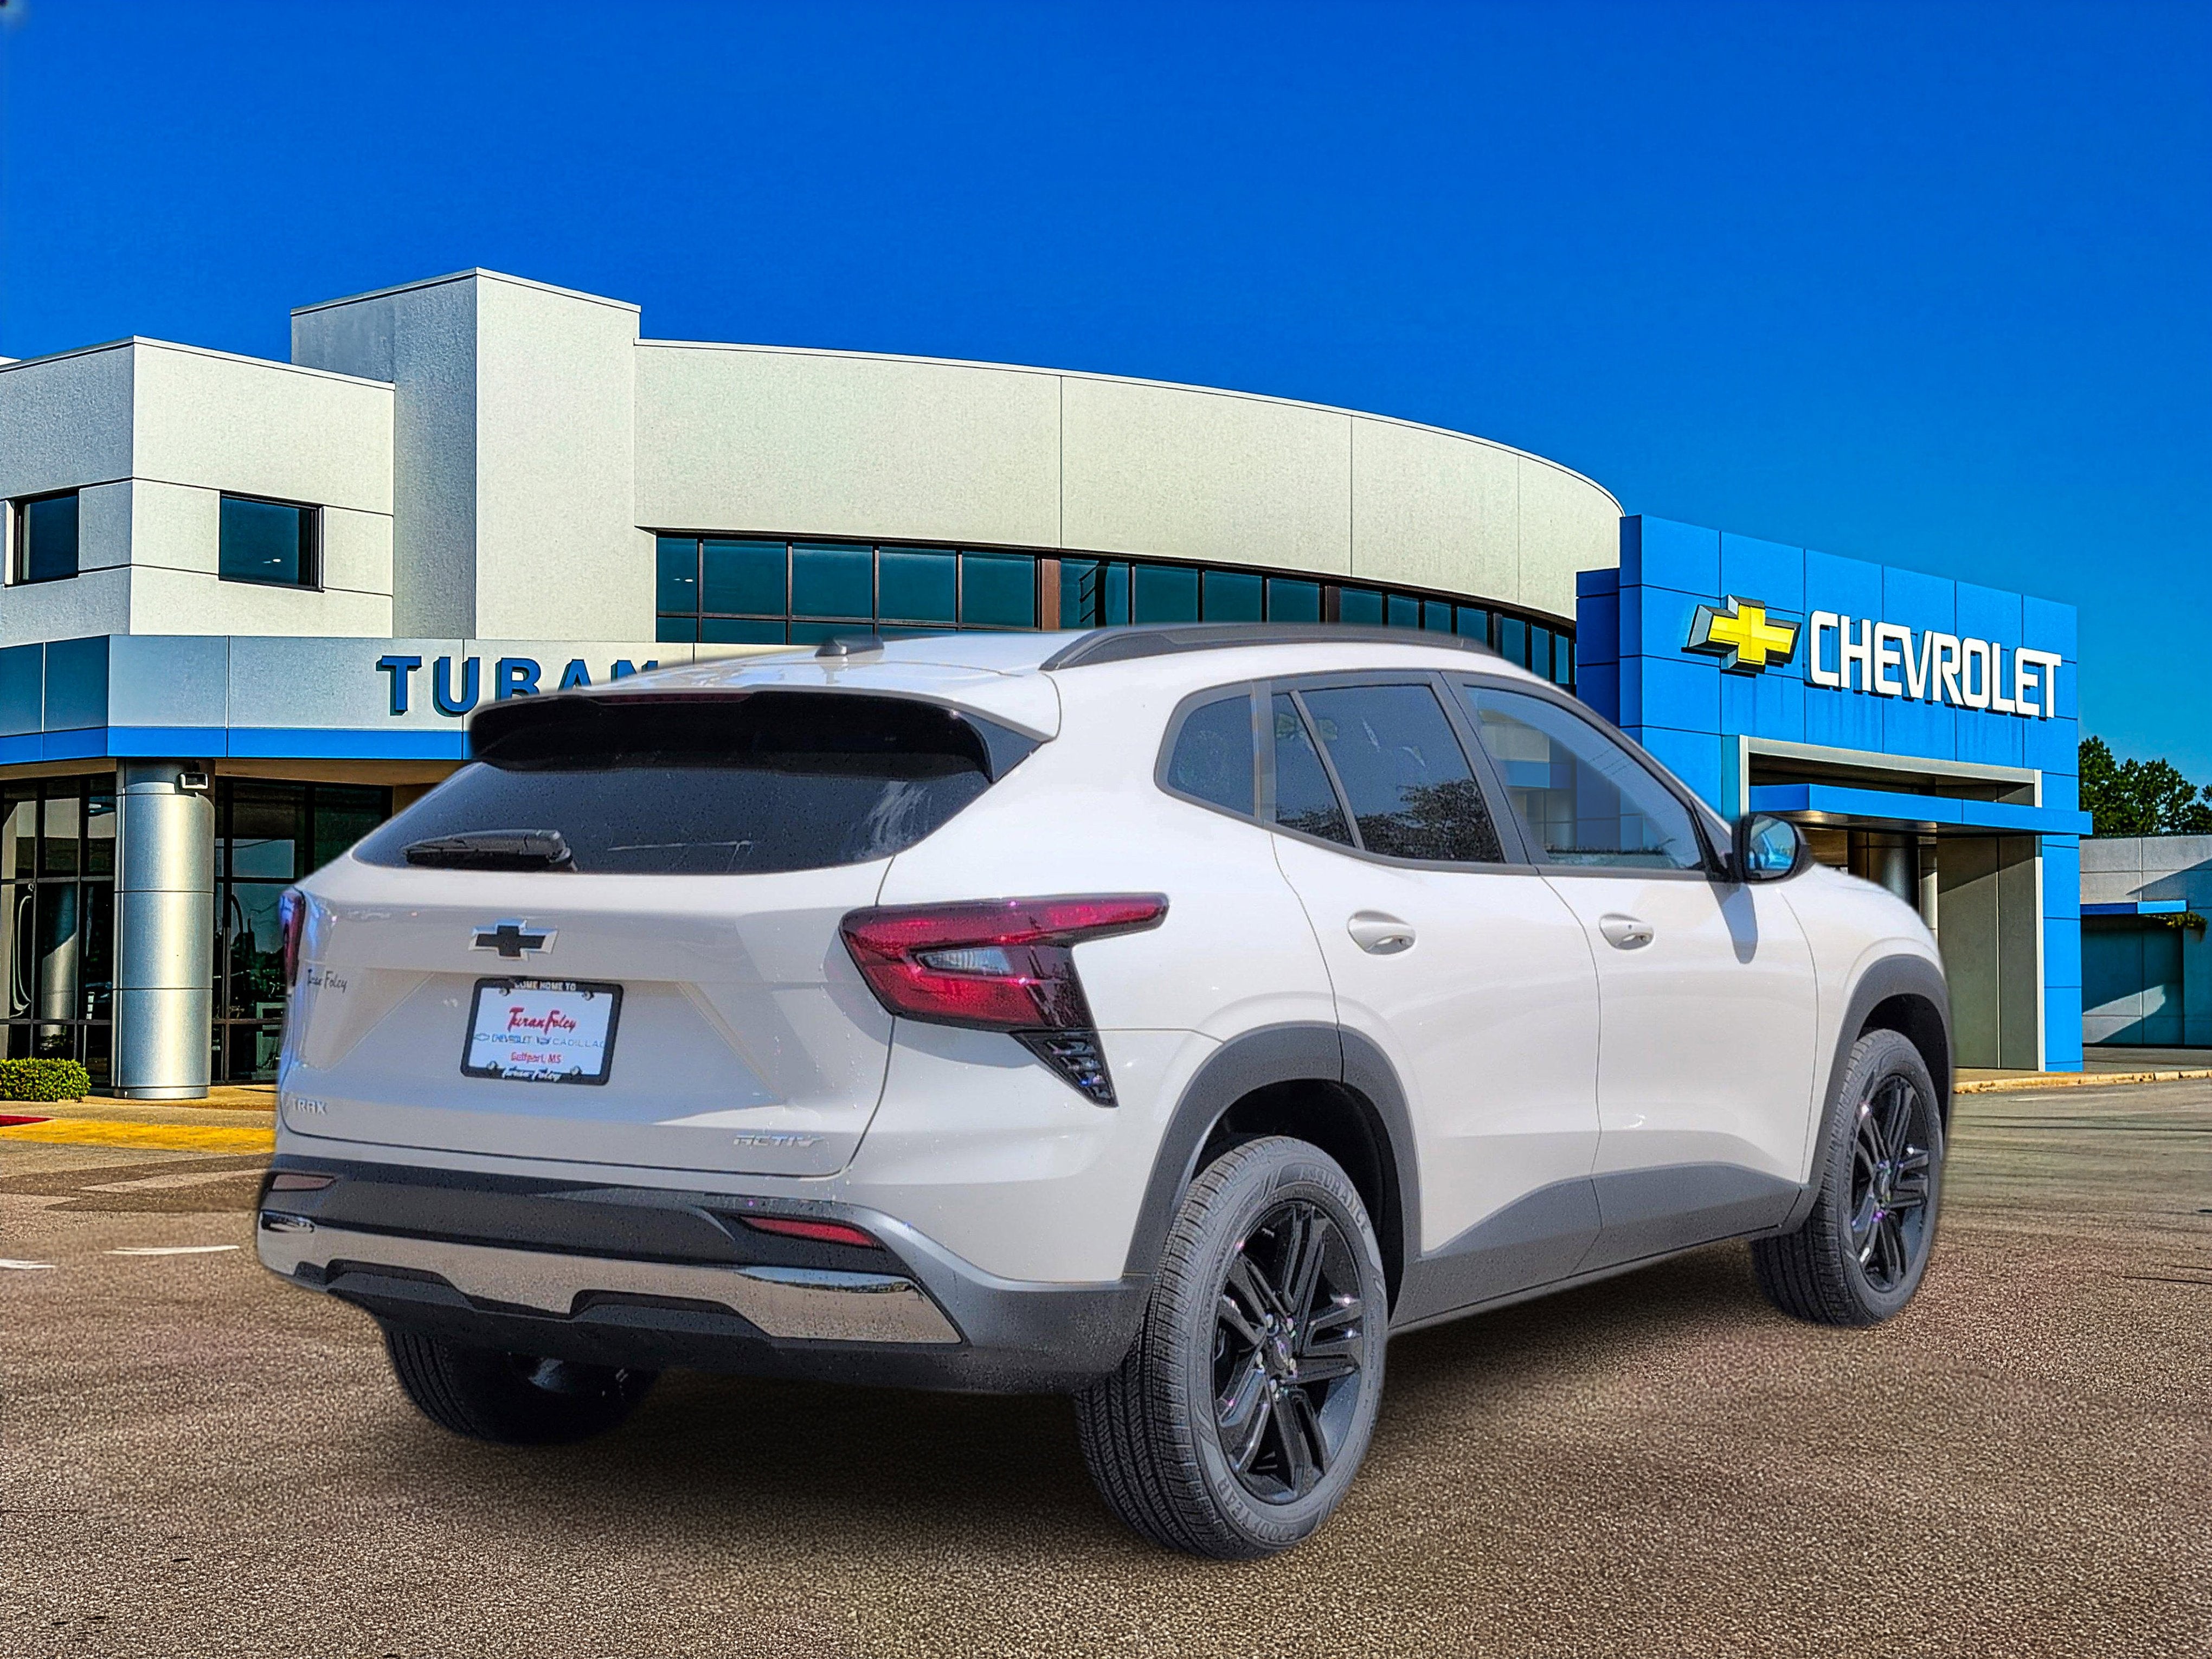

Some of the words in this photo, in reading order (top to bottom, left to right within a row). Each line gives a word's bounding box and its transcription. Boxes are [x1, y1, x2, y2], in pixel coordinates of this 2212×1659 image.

[1810, 609, 2062, 718] CHEVROLET
[324, 970, 348, 994] Foley
[539, 981, 563, 991] HOME
[565, 982, 576, 992] TO
[291, 1098, 327, 1114] TRAX
